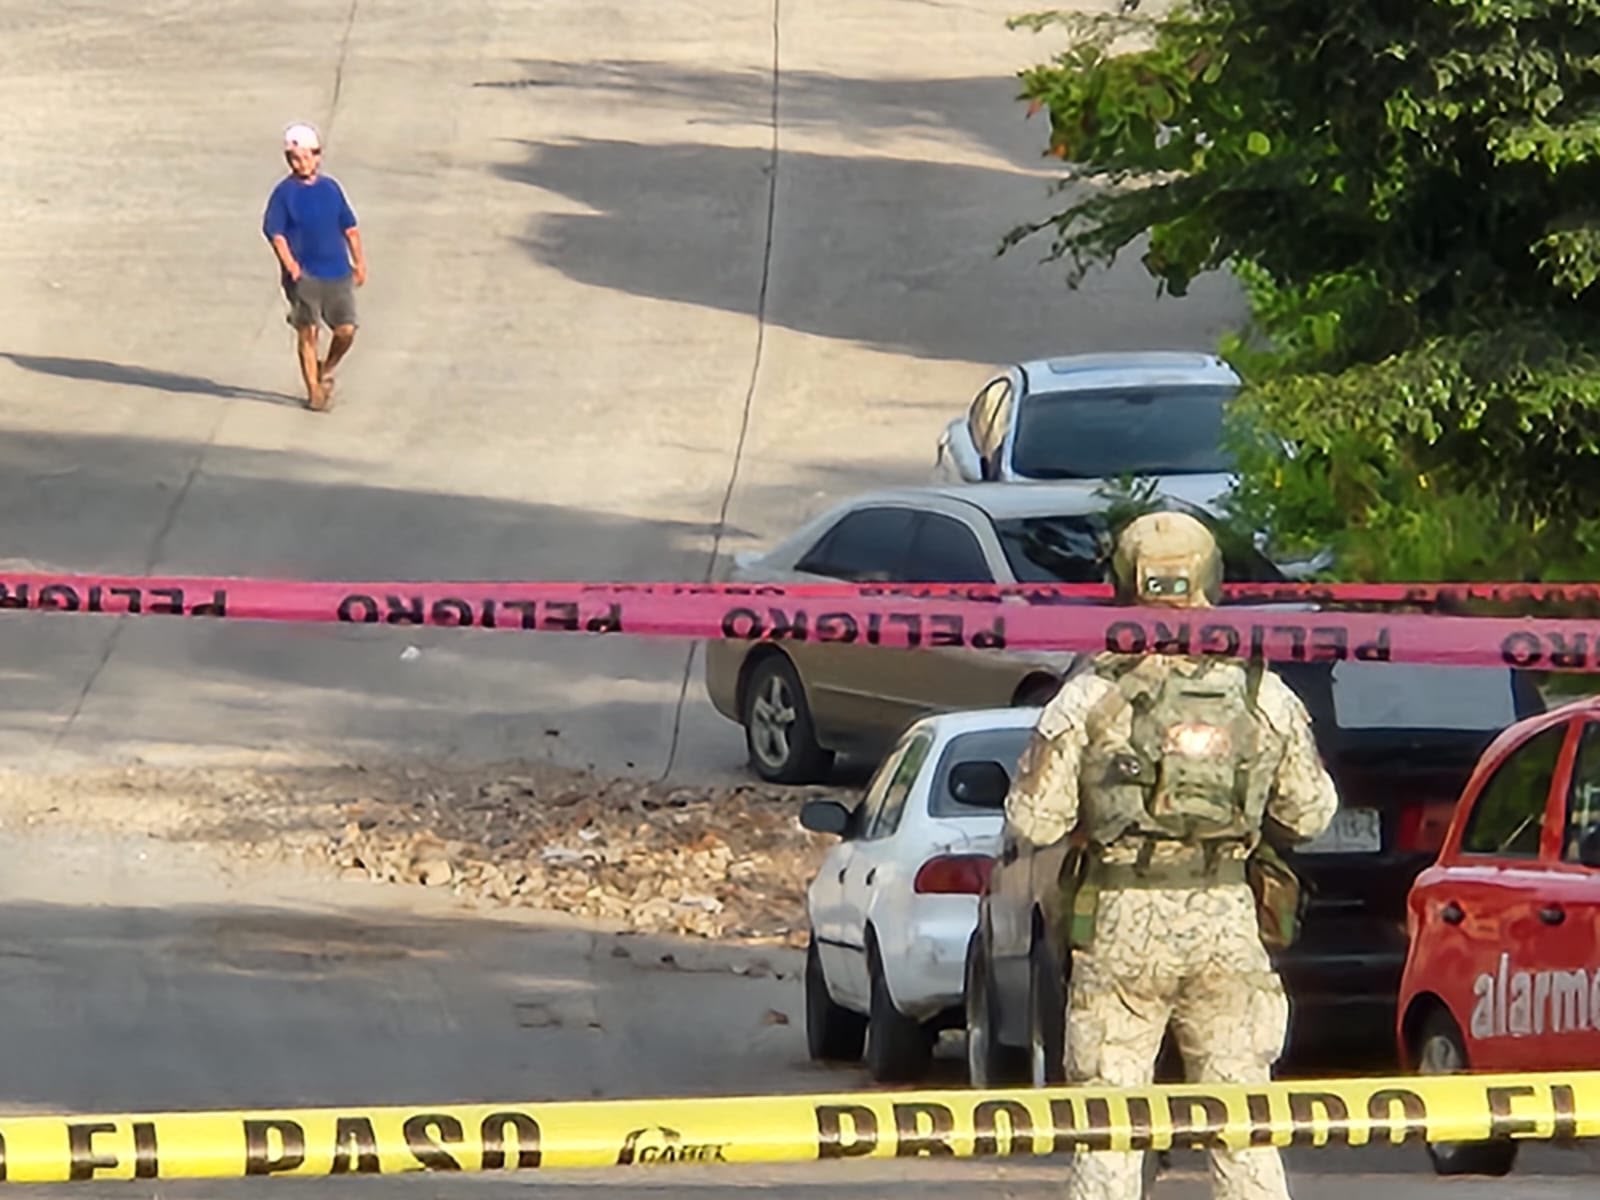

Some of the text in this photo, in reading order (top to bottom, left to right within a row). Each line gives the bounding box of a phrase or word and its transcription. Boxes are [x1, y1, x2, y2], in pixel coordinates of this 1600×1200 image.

[336, 594, 623, 632] PELIGRO
[722, 607, 1007, 648] PELIGRO
[1105, 620, 1391, 661] PELIGRO
[1501, 631, 1600, 668] RO
[243, 1112, 541, 1175] PASO
[816, 1089, 1429, 1159] PROHIBIDO
